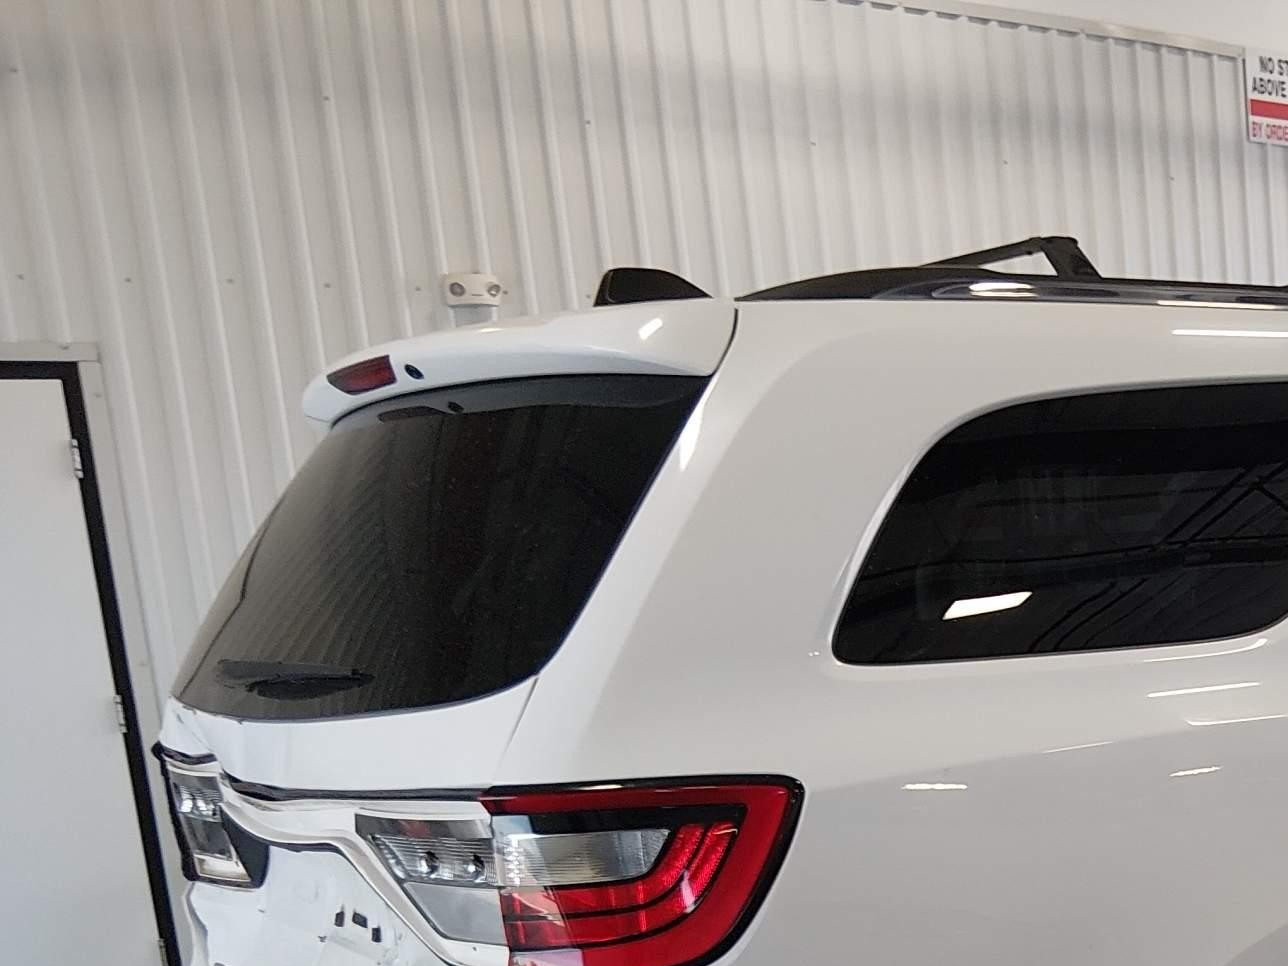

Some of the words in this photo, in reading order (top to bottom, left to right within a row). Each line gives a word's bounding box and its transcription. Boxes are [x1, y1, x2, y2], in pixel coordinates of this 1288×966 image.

[1258, 56, 1274, 74] NO
[1252, 77, 1287, 98] ABOVE
[1252, 121, 1263, 138] BY
